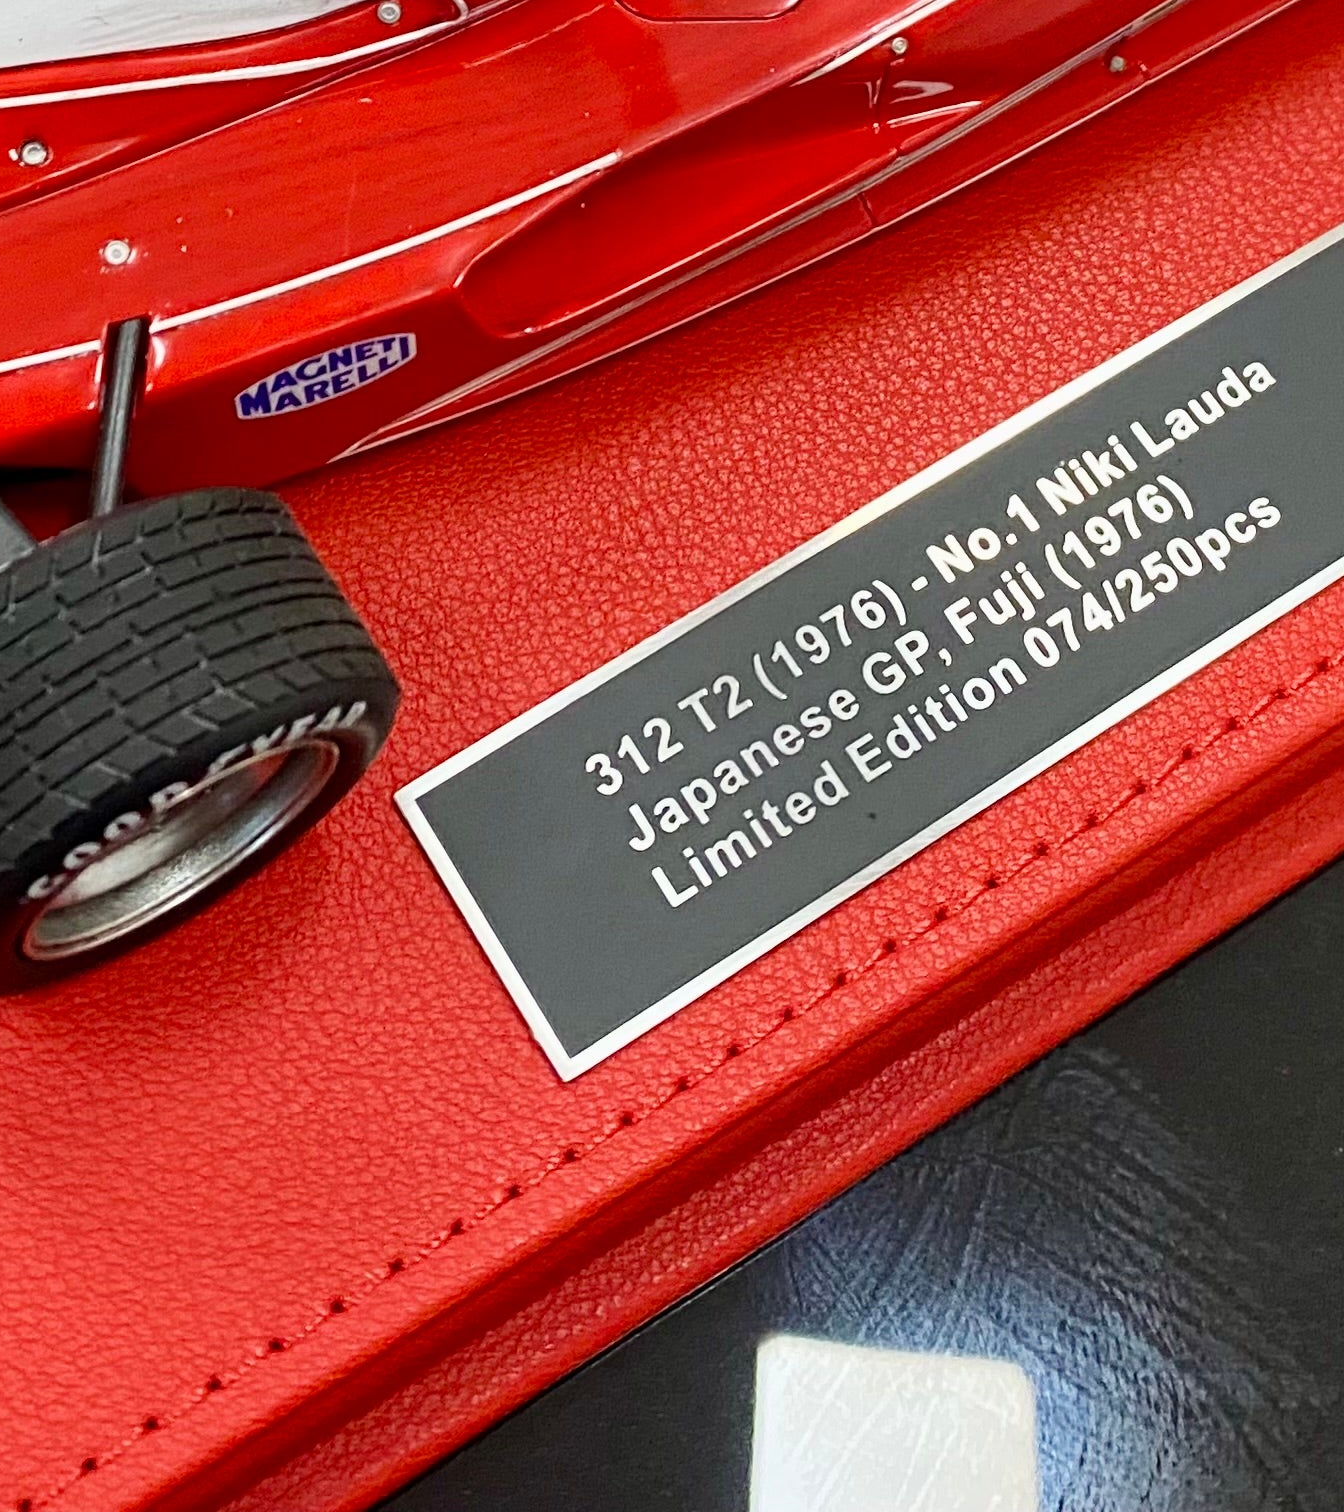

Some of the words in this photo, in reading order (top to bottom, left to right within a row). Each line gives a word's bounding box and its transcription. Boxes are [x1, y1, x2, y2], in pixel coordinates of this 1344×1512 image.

[240, 335, 409, 417] MAGNETI
[585, 716, 685, 797] 312
[676, 674, 755, 734] T2
[752, 578, 908, 701] (1976)
[925, 493, 1041, 585] No.1
[1035, 433, 1139, 517] Niki
[1128, 360, 1278, 459] Lauda
[627, 687, 861, 853] Japanese
[861, 629, 954, 695] GP,
[942, 560, 1047, 646] Fuji
[1043, 473, 1195, 591] (1976)
[650, 758, 851, 909] Limited
[843, 656, 1029, 784] Edition
[1022, 495, 1283, 669] 074/250pcs
